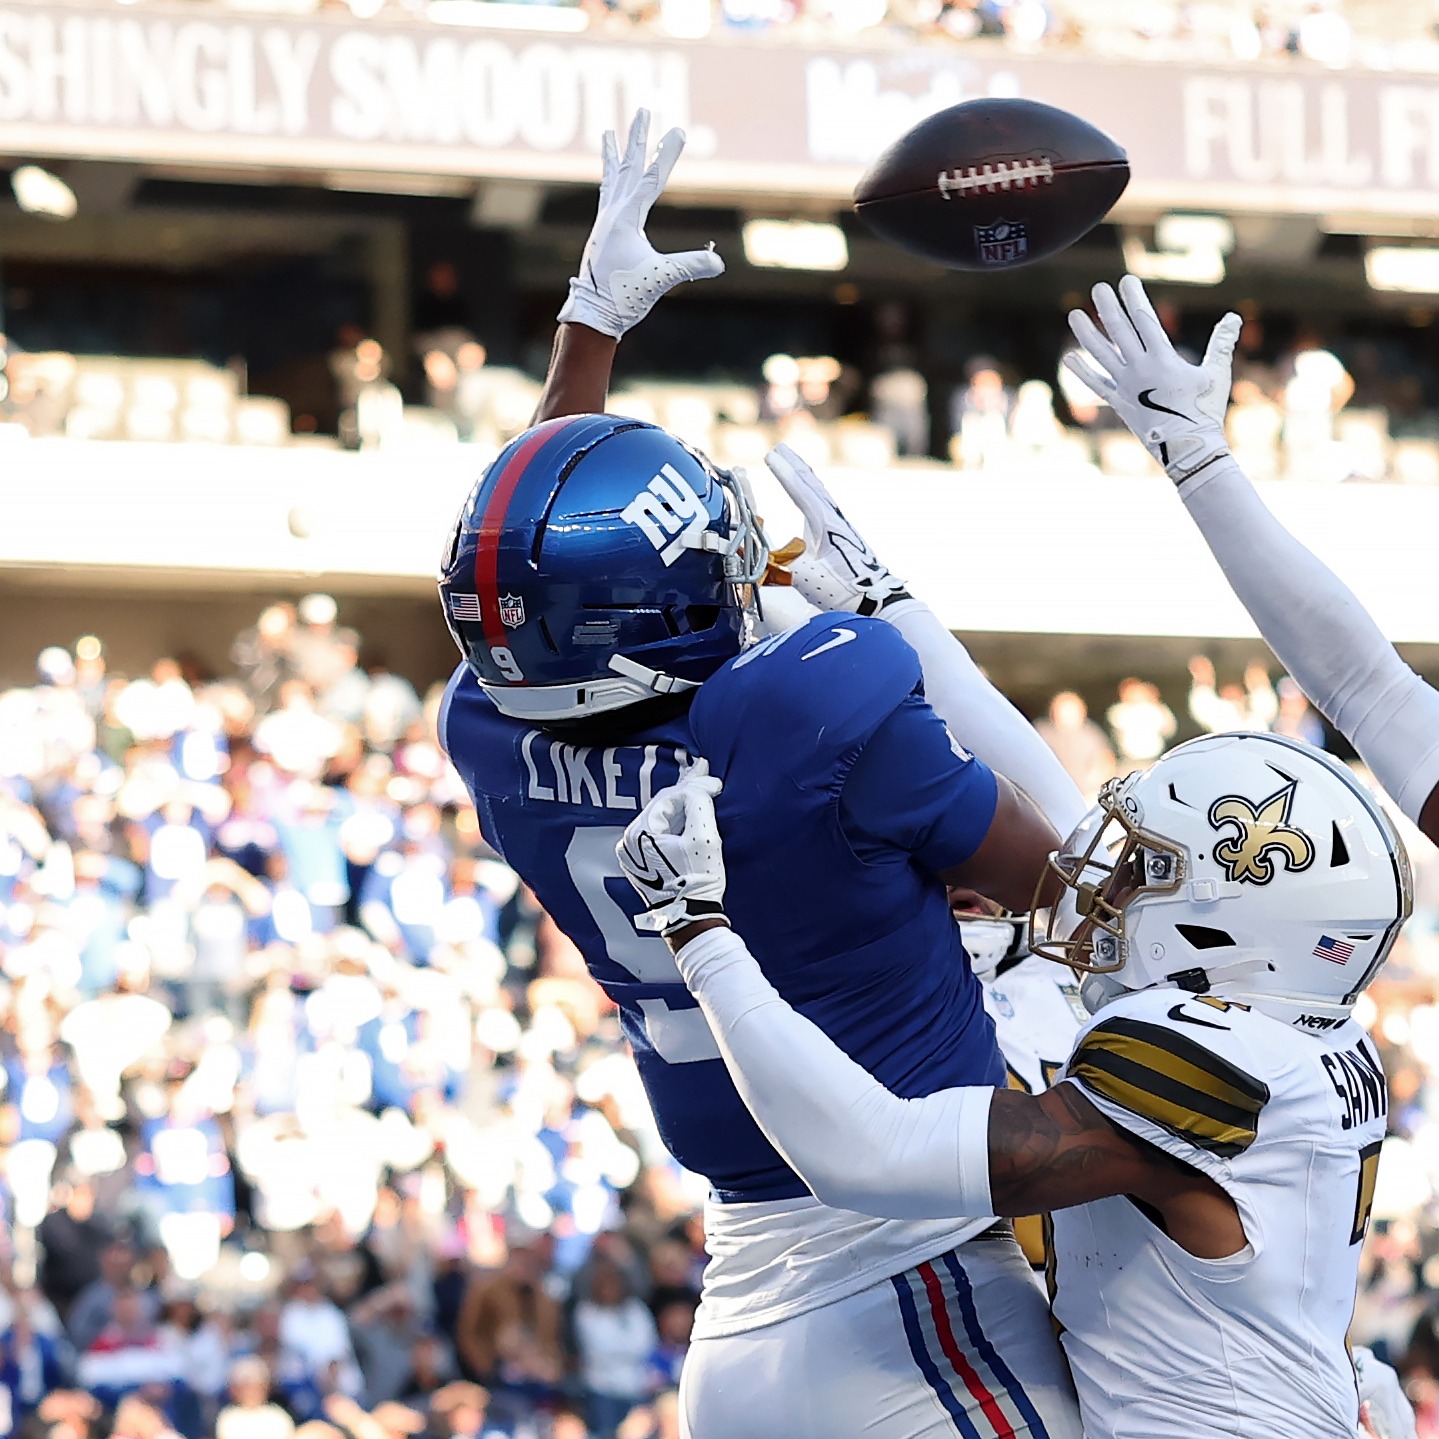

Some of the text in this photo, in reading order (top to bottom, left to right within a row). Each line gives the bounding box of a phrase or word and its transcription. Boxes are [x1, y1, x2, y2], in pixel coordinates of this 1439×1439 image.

[1182, 76, 1373, 186] FULL
[490, 646, 525, 682] 9
[1292, 1013, 1336, 1031] NEW
